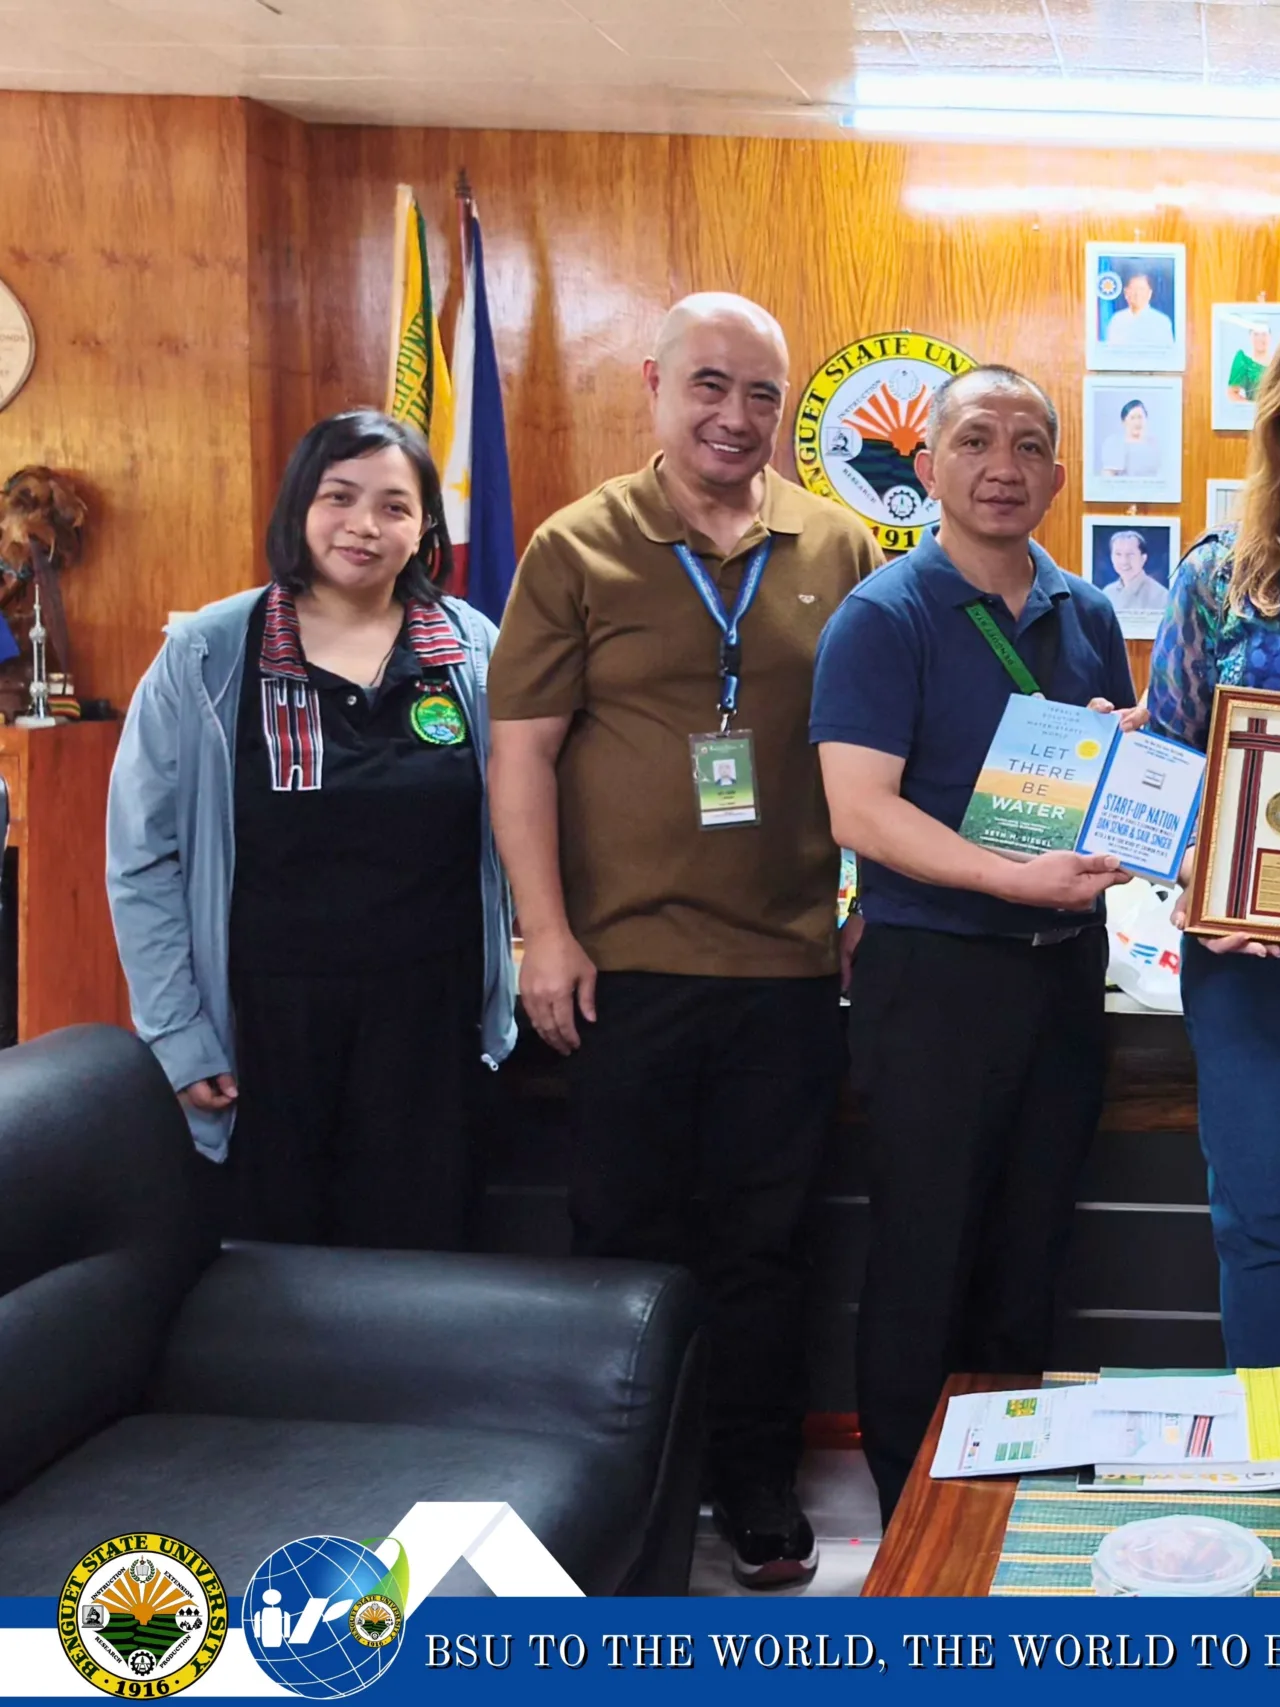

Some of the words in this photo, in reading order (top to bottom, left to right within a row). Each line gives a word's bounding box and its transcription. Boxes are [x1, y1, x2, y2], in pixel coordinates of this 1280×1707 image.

[825, 336, 910, 384] STATE
[871, 526, 917, 548] 191
[1030, 743, 1070, 760] LET
[1008, 758, 1077, 781] THERE
[1021, 781, 1050, 797] BE
[991, 795, 1066, 820] WATER
[1103, 793, 1148, 820] START-UP
[1146, 806, 1181, 833] NATION
